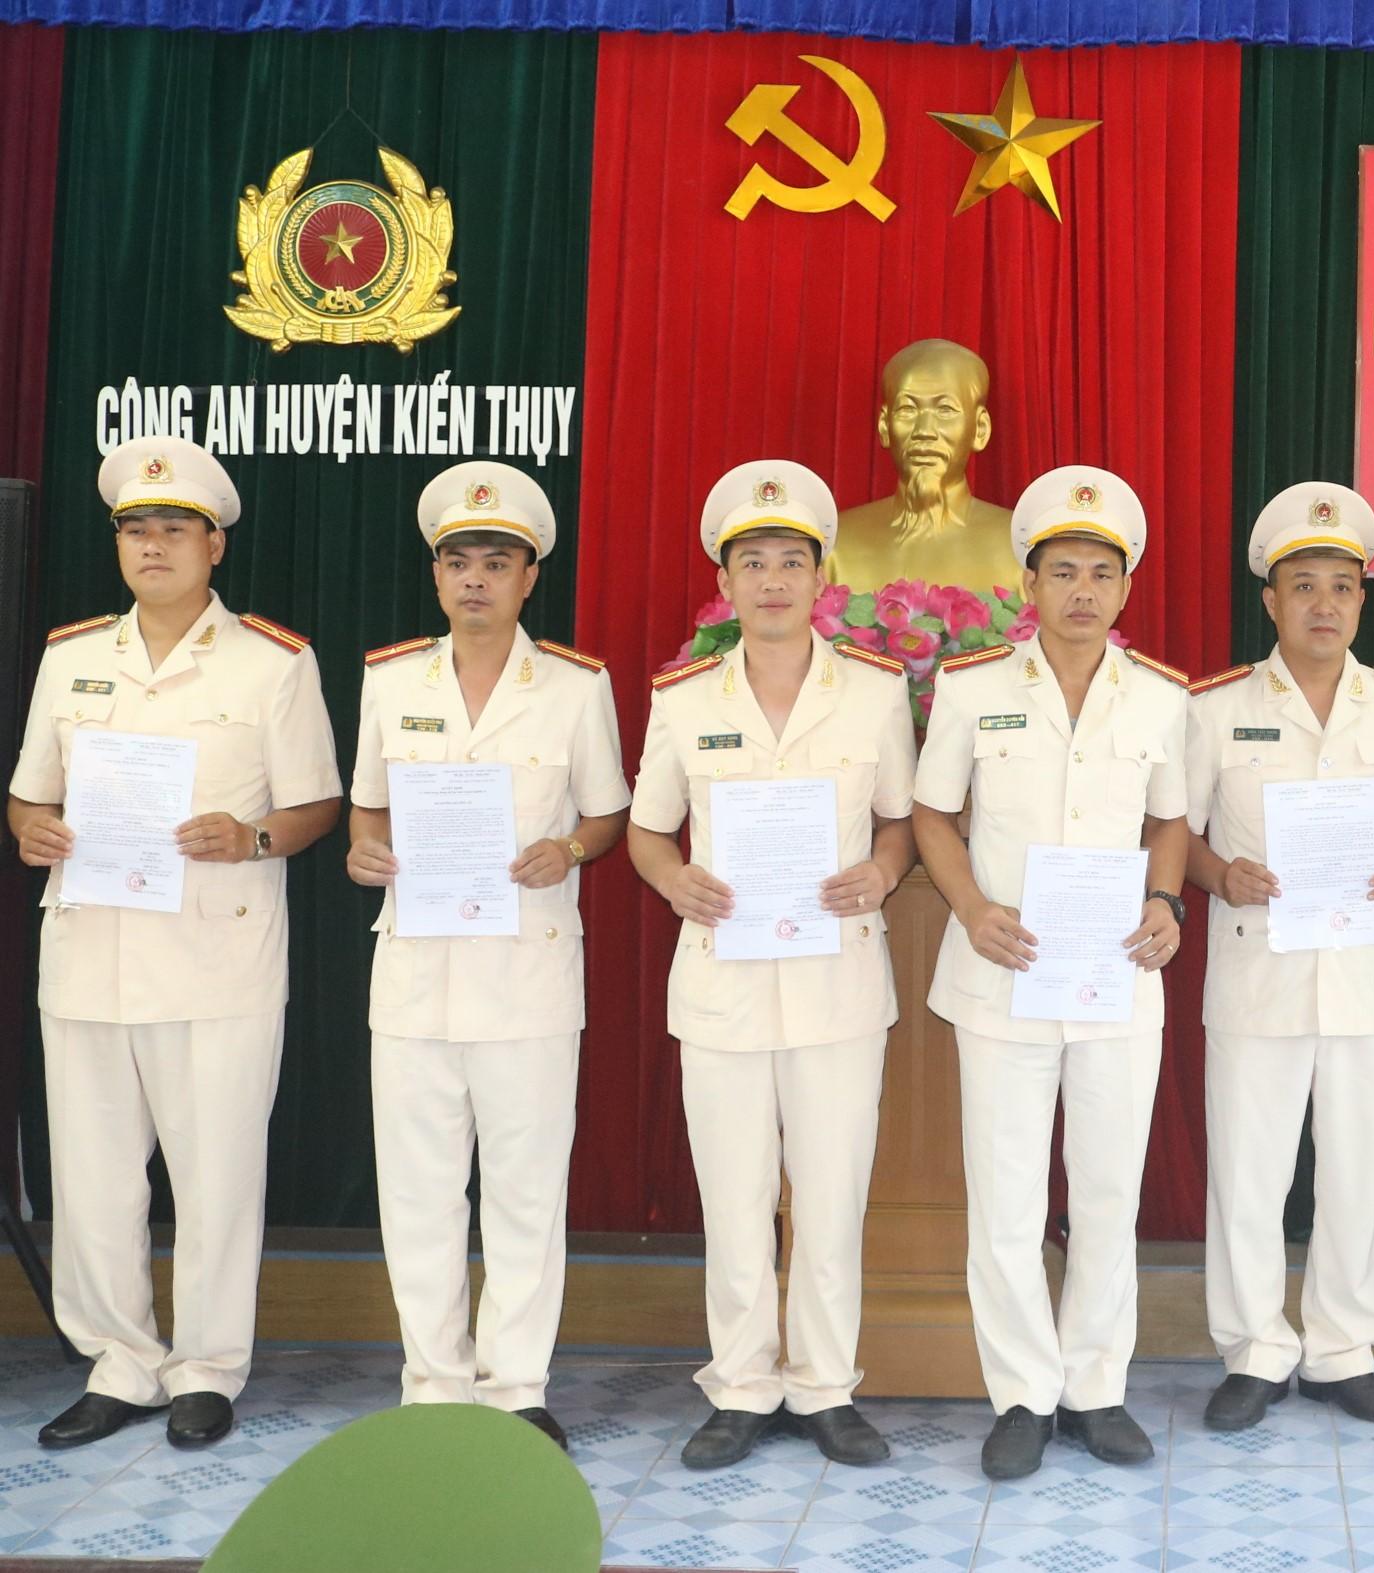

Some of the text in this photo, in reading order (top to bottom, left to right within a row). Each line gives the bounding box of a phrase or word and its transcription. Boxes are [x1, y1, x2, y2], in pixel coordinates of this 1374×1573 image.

[97, 369, 577, 467] CÔNG AN HUYỆN KIẾN THỤY
